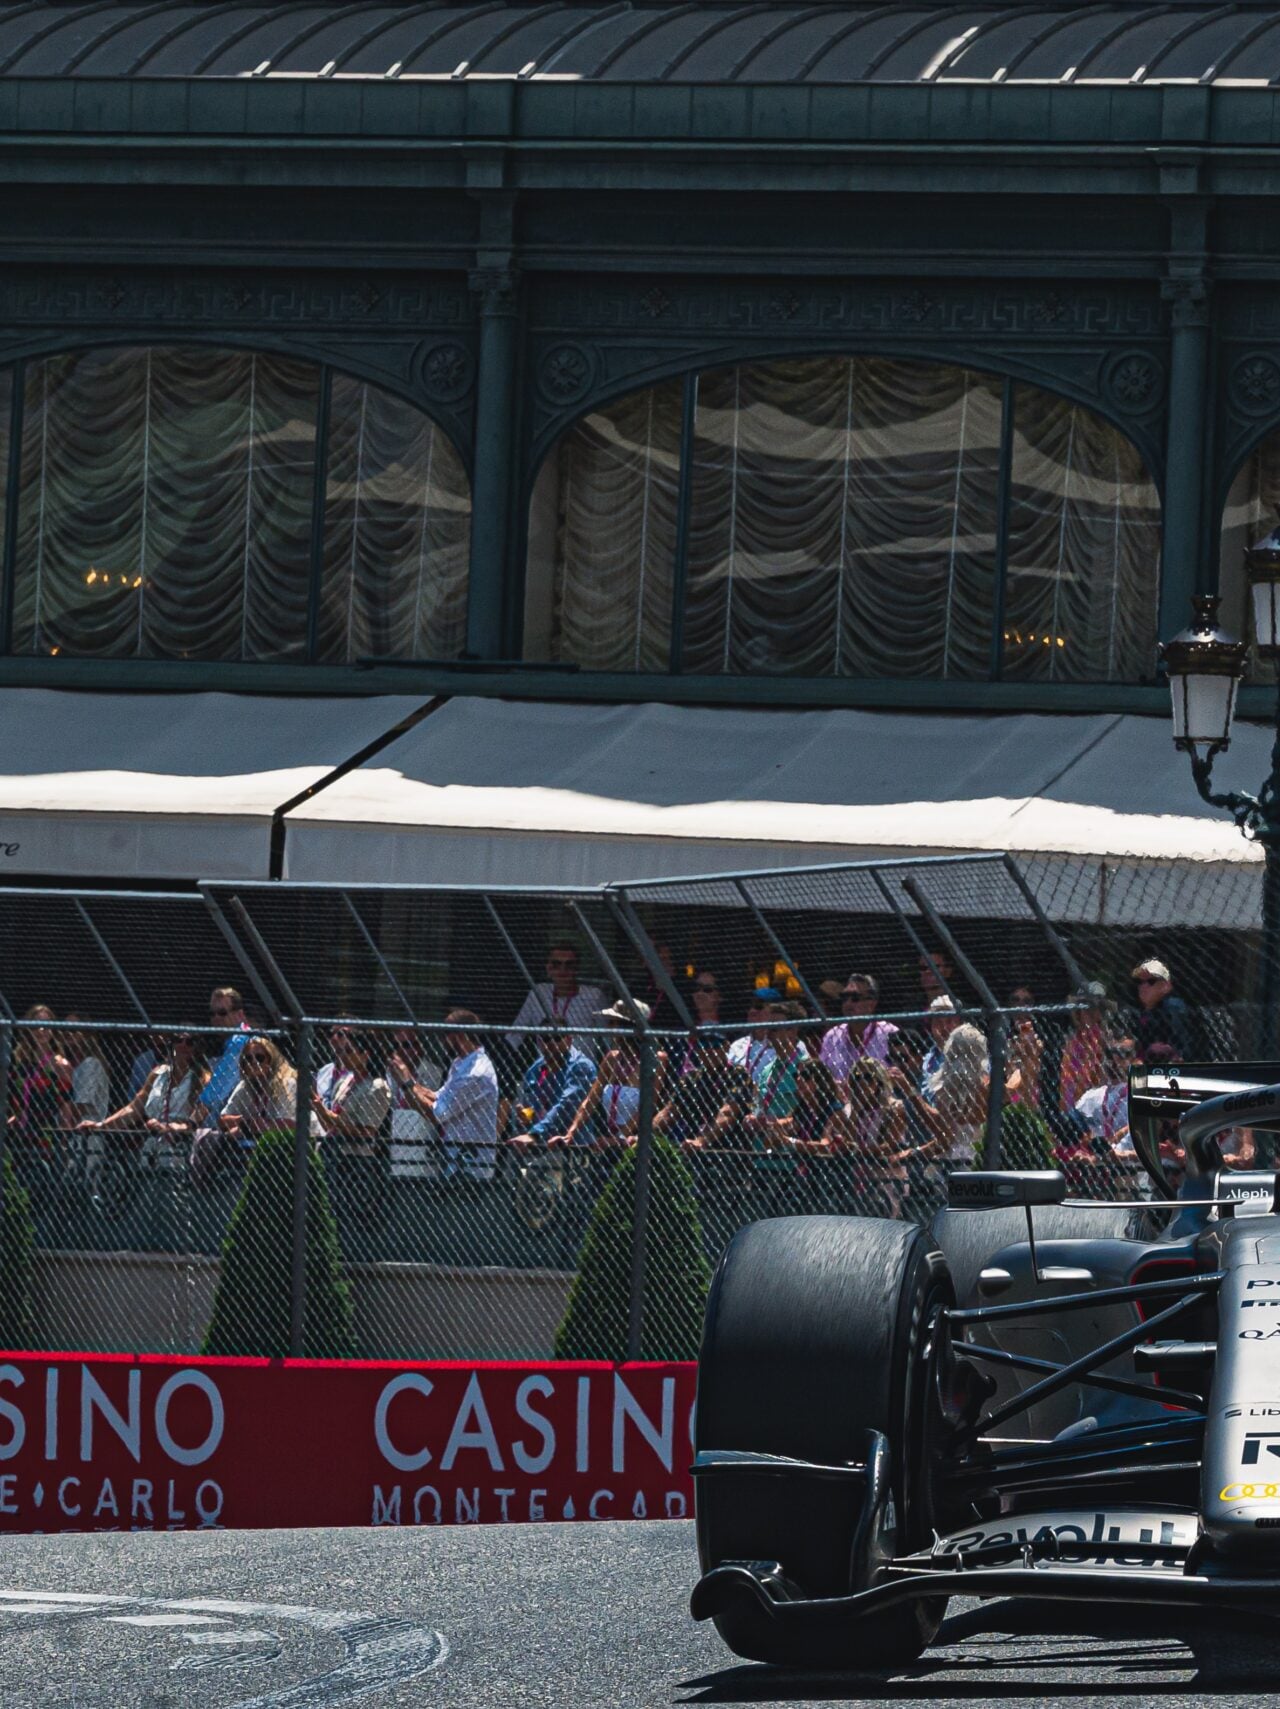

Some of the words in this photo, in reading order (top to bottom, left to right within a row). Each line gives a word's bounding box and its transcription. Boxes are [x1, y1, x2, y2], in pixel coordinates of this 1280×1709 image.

[1226, 1187, 1269, 1200] Aleph
[0, 1363, 225, 1466] SINO
[374, 1371, 698, 1475] CASIN
[58, 1476, 225, 1526] CARLO
[371, 1484, 547, 1525] MONTE
